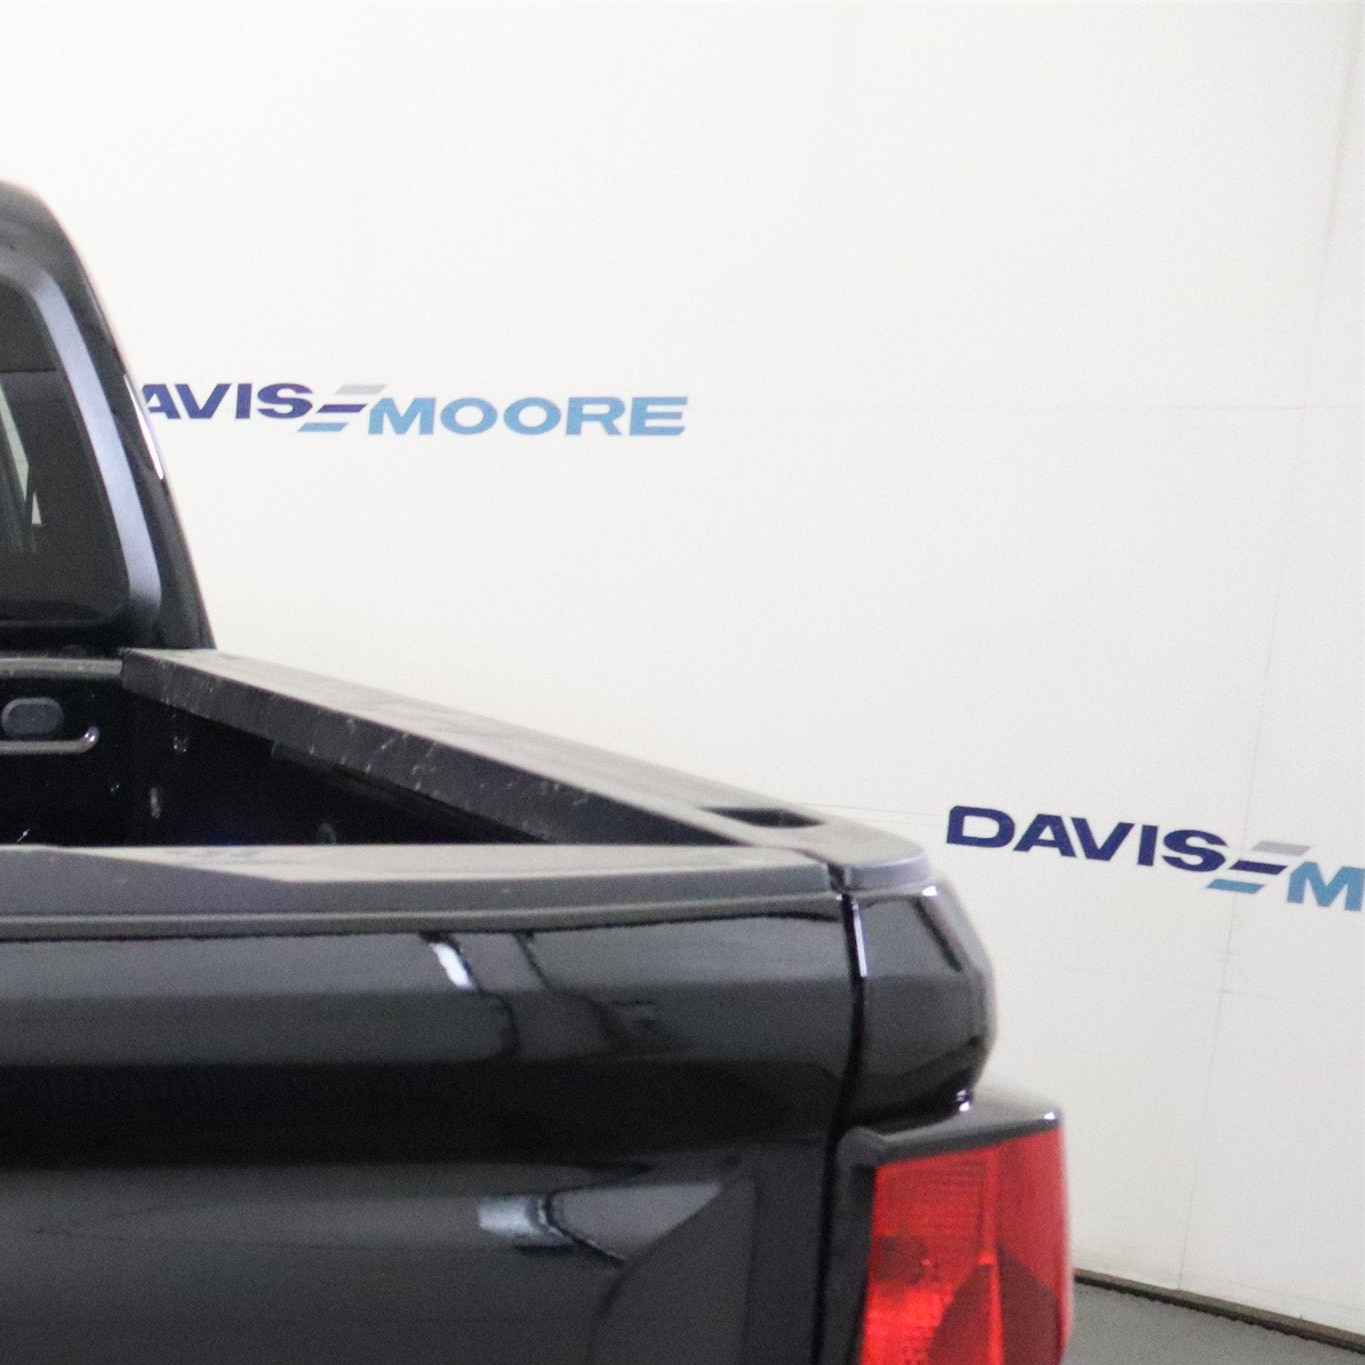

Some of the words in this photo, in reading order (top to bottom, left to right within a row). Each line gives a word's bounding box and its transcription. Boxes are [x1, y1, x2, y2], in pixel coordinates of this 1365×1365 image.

[141, 382, 315, 420] AVIS
[368, 395, 689, 437] MOORE
[945, 804, 1228, 873] DAVIS
